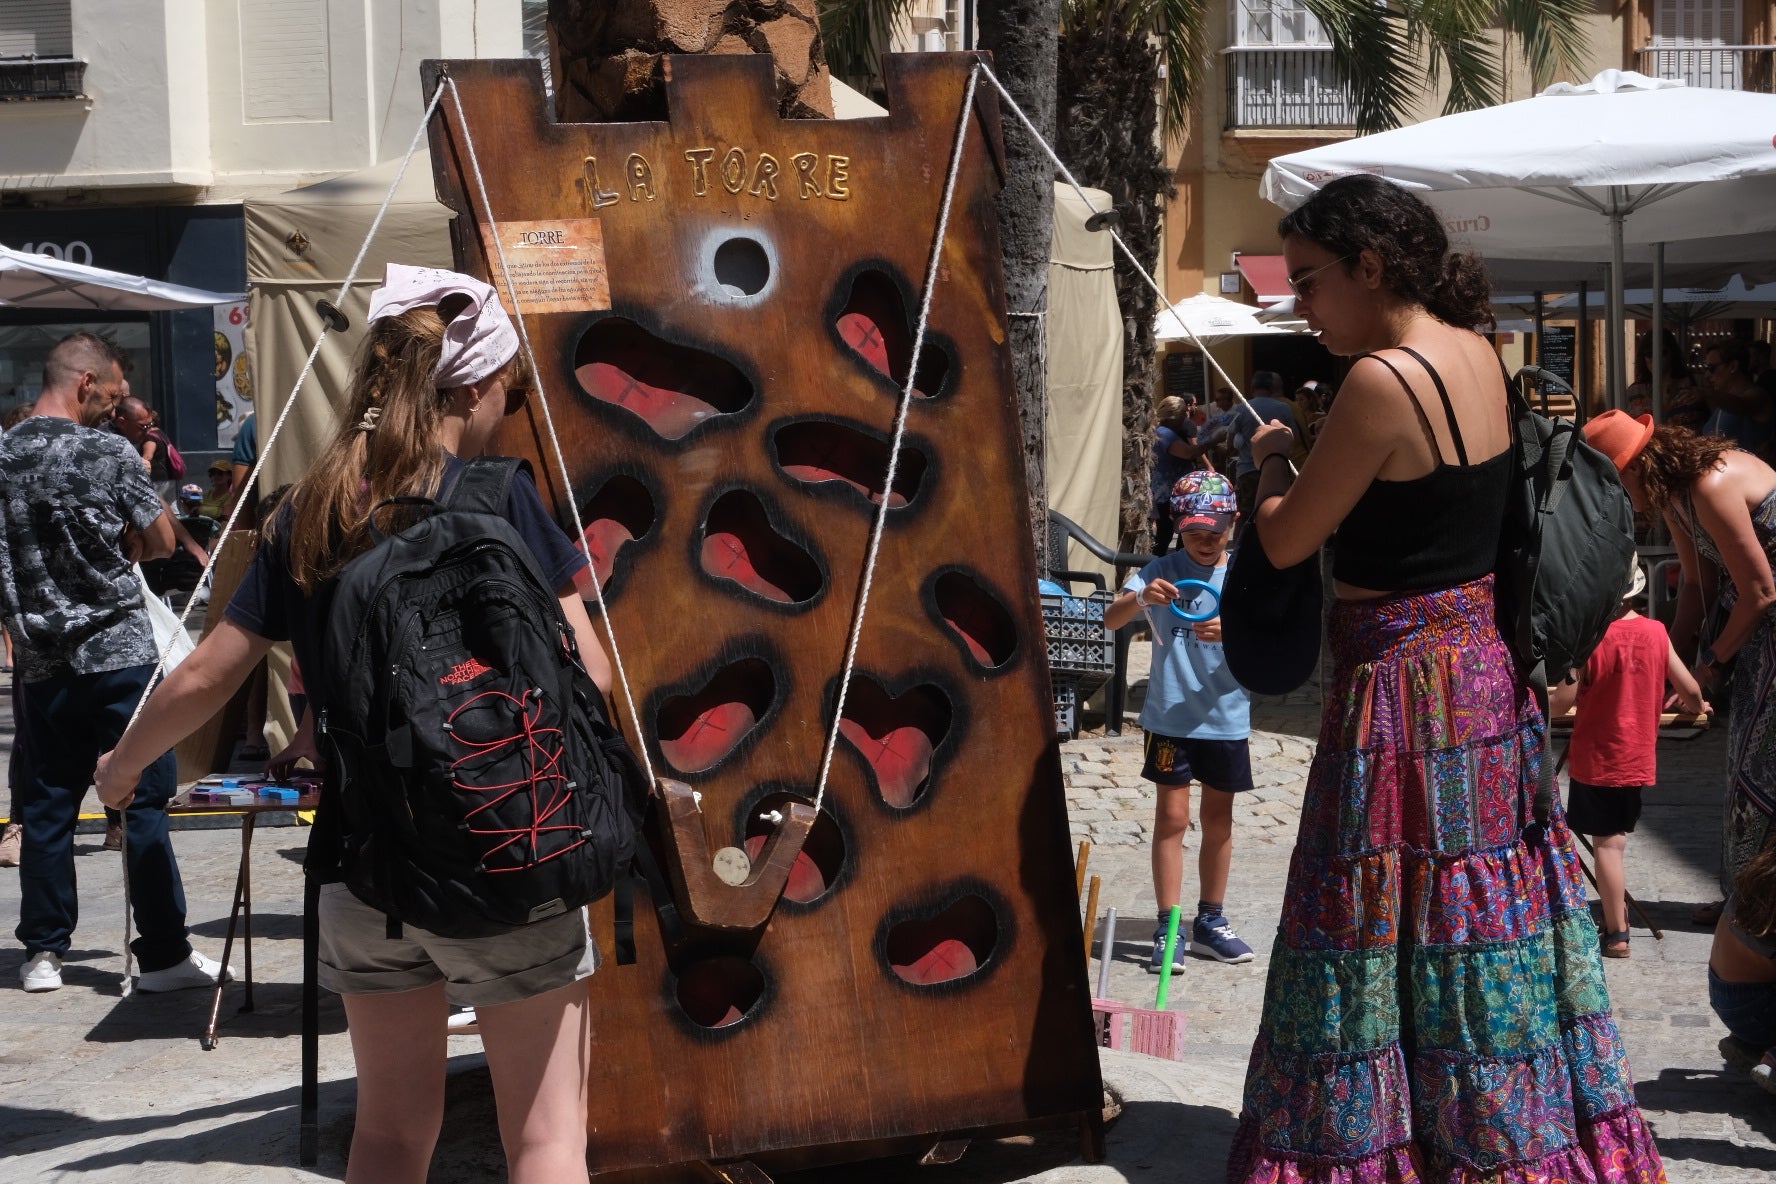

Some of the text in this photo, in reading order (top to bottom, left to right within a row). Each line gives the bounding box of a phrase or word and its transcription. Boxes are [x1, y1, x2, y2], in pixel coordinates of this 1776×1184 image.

[584, 147, 850, 210] LA TORRE
[520, 231, 565, 245] TORRE
[451, 660, 472, 672] THE
[440, 667, 475, 684] NORTH
[452, 673, 475, 685] FACE
